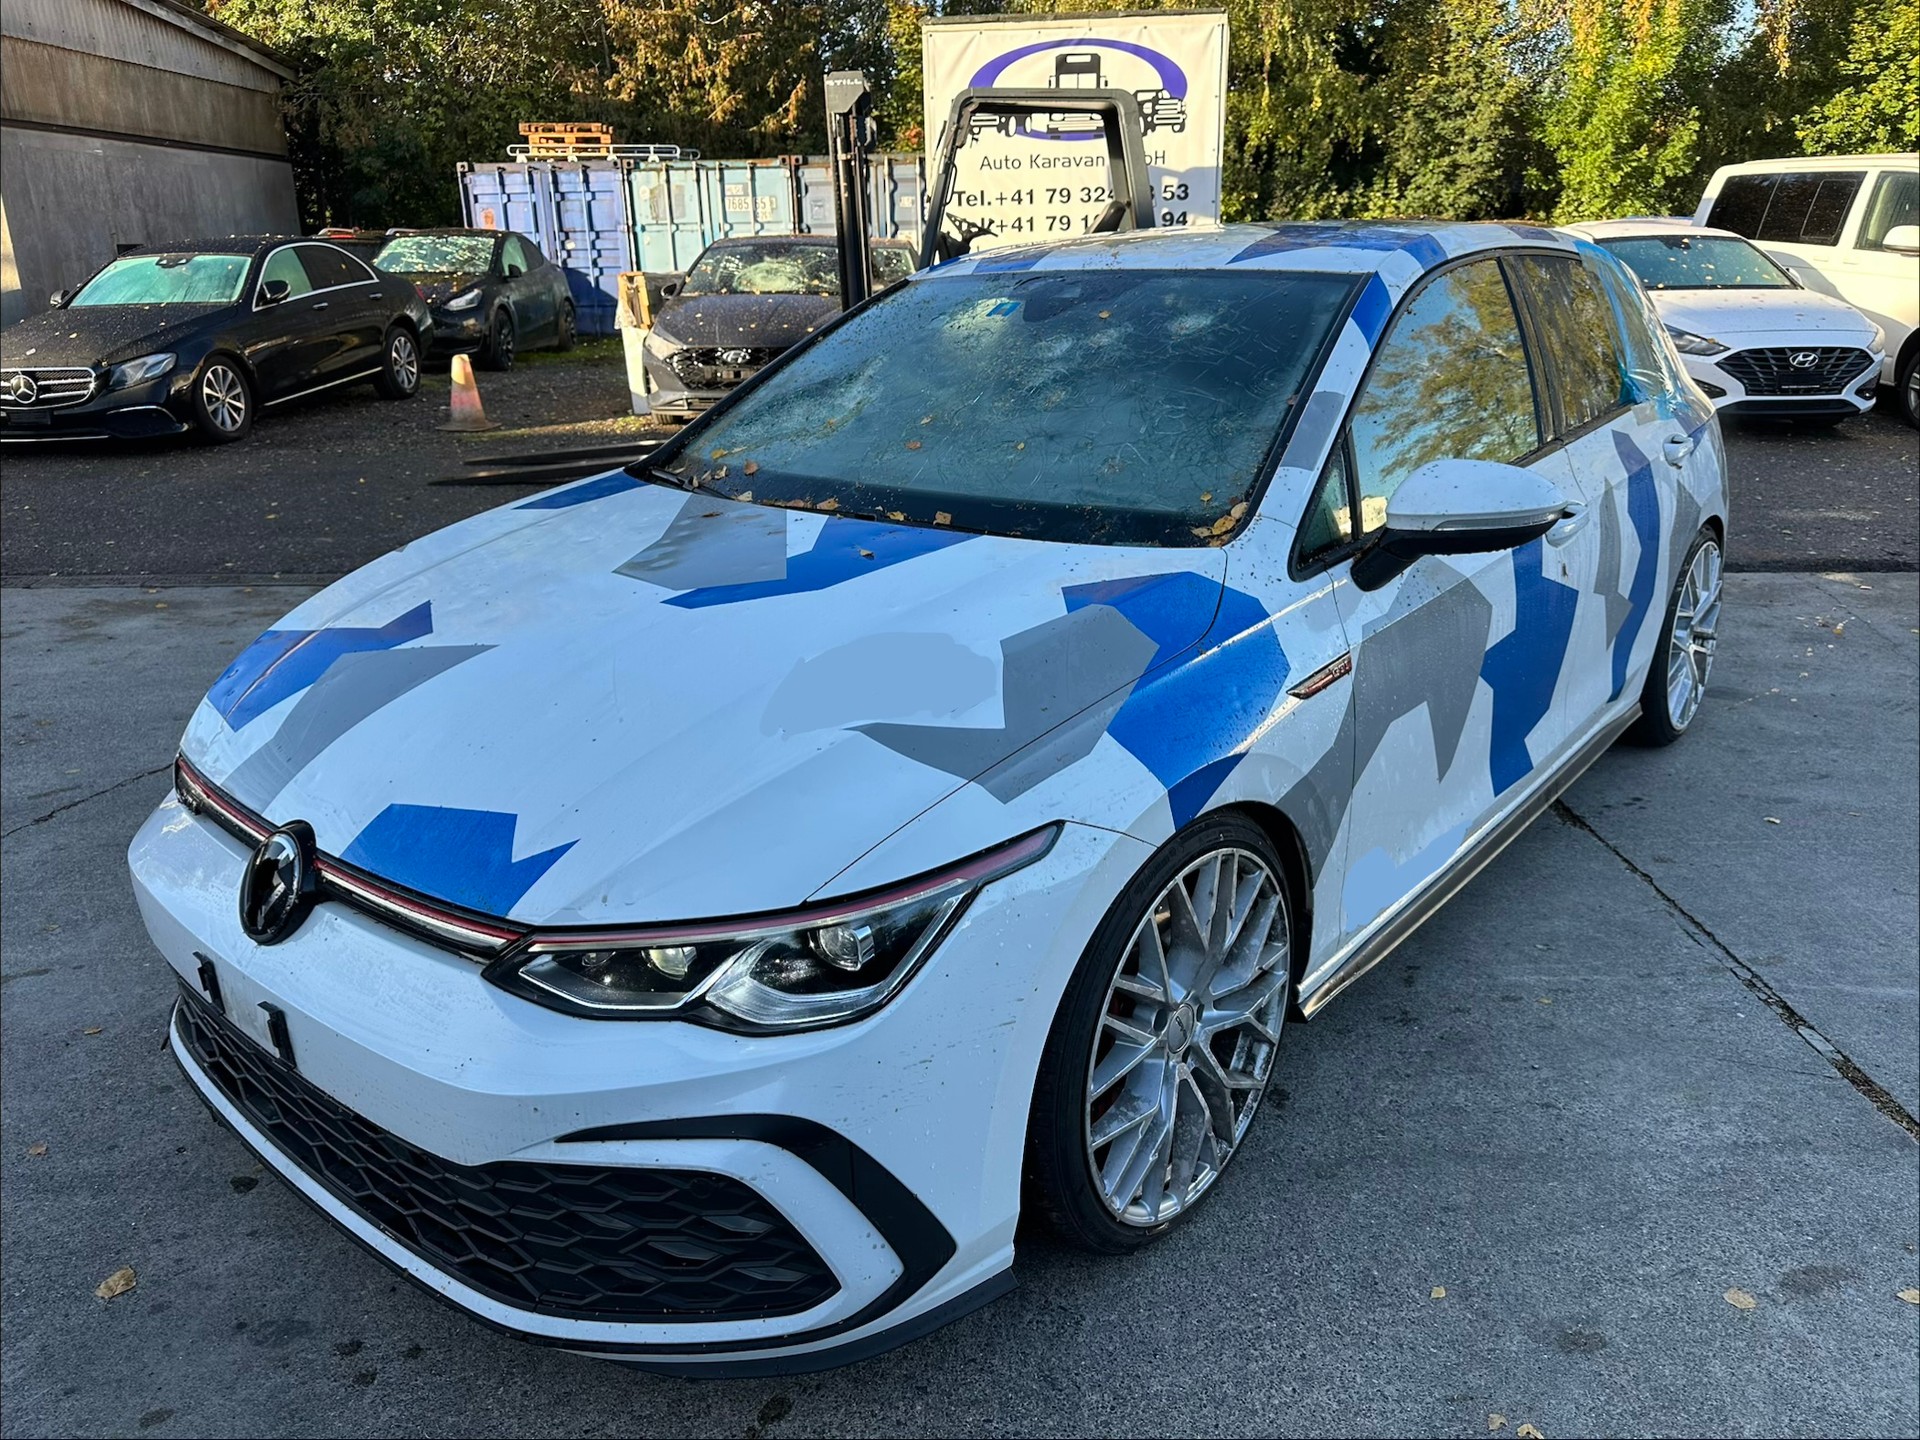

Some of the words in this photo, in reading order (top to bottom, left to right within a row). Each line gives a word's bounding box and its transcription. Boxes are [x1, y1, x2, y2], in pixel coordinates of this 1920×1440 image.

[980, 155, 1022, 170] Auto
[1029, 153, 1105, 169] Karavan
[1045, 188, 1071, 205] 79
[1162, 183, 1190, 201] 53
[1045, 215, 1072, 232] 79
[1161, 211, 1188, 227] 94
